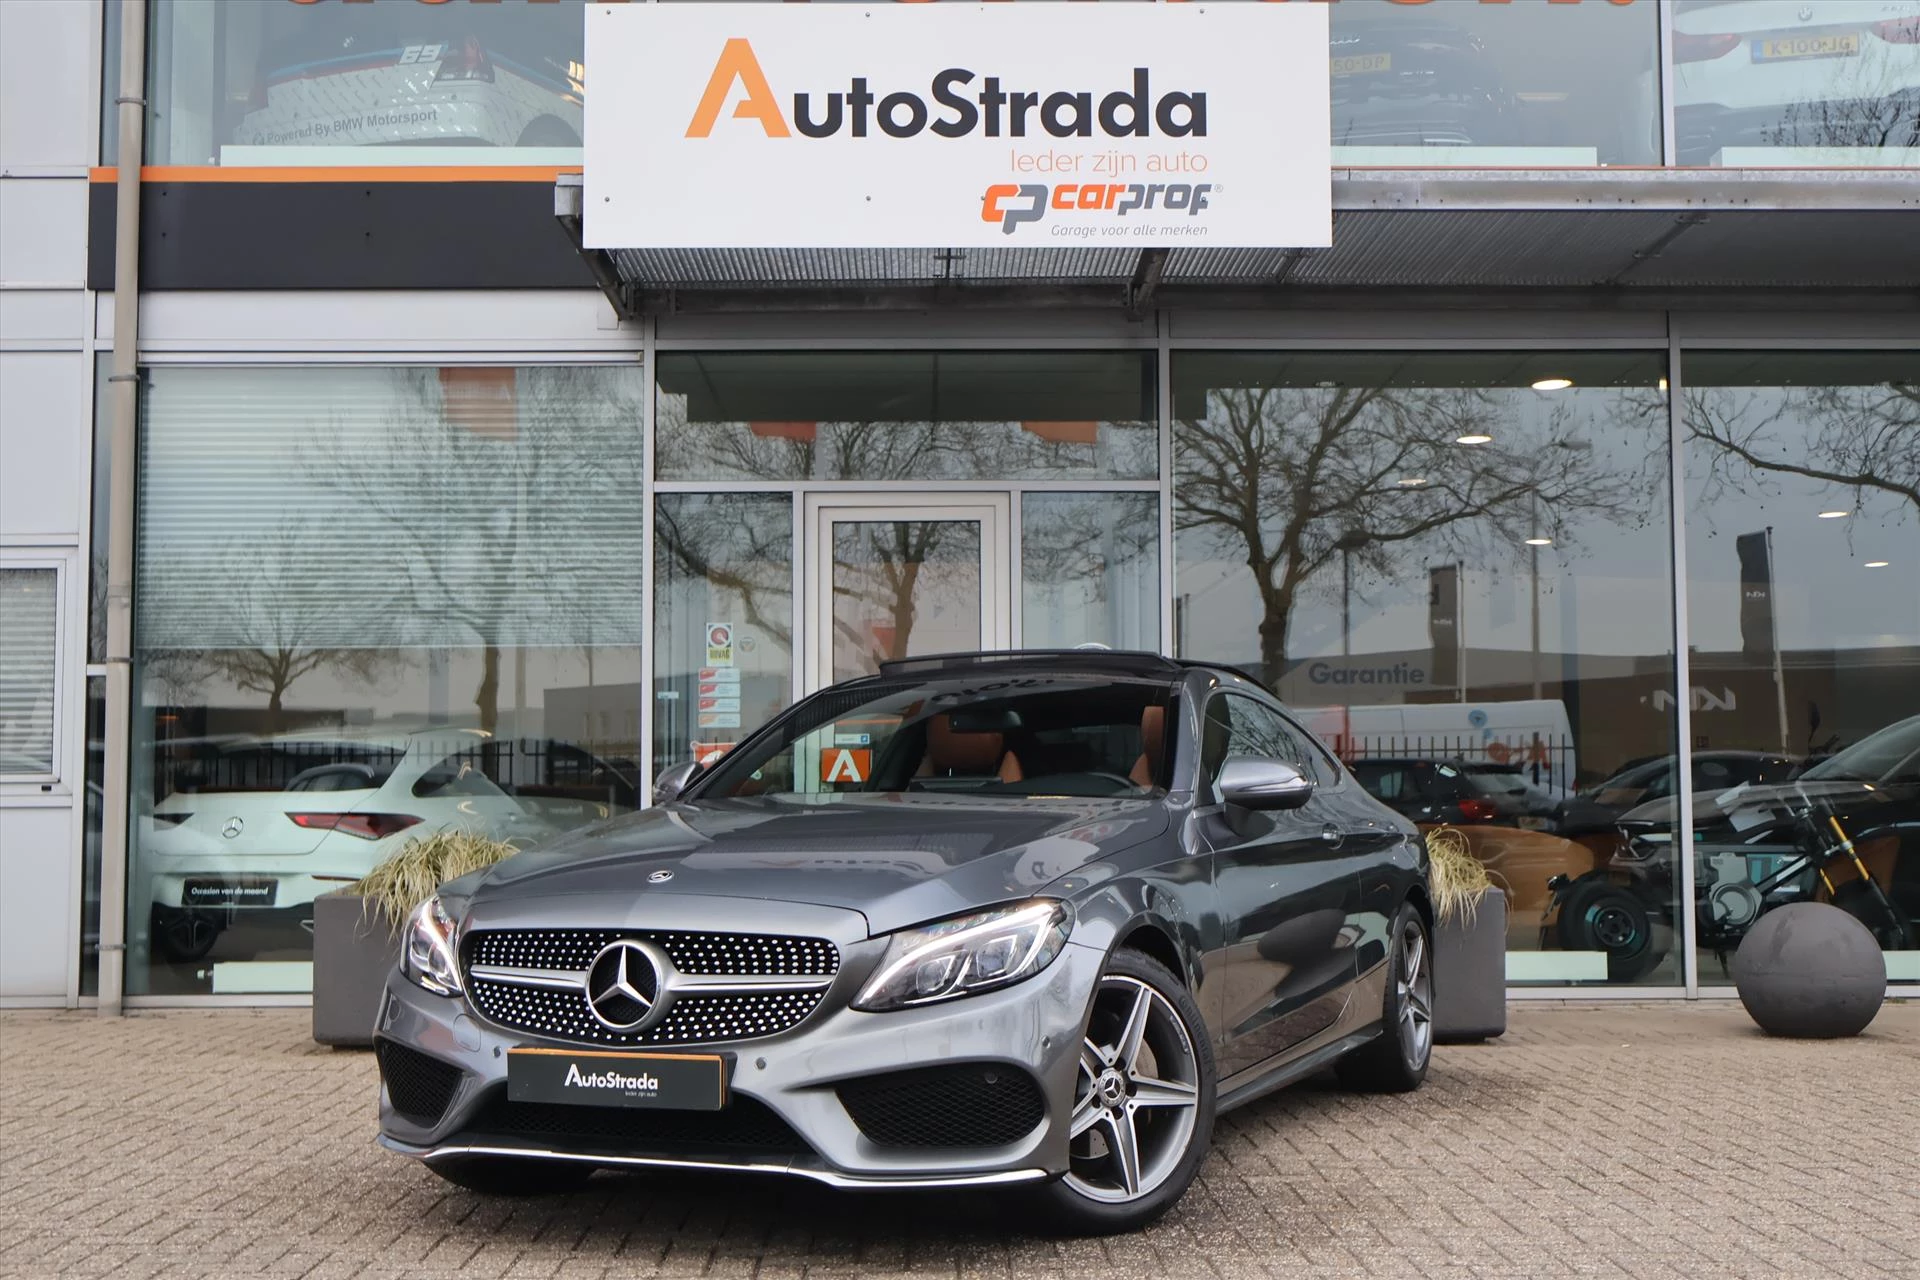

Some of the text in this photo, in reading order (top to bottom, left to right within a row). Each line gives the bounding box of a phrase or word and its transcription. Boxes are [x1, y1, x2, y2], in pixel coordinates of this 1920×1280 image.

[684, 38, 1208, 138] AutoStrada
[267, 109, 438, 143] Powered By BMW Motorsport
[1011, 149, 1208, 178] Ieder zijn auto
[1051, 224, 1208, 239] Garage voor alle merken
[1308, 661, 1425, 685] Garantie
[564, 1064, 658, 1090] AutoStrada
